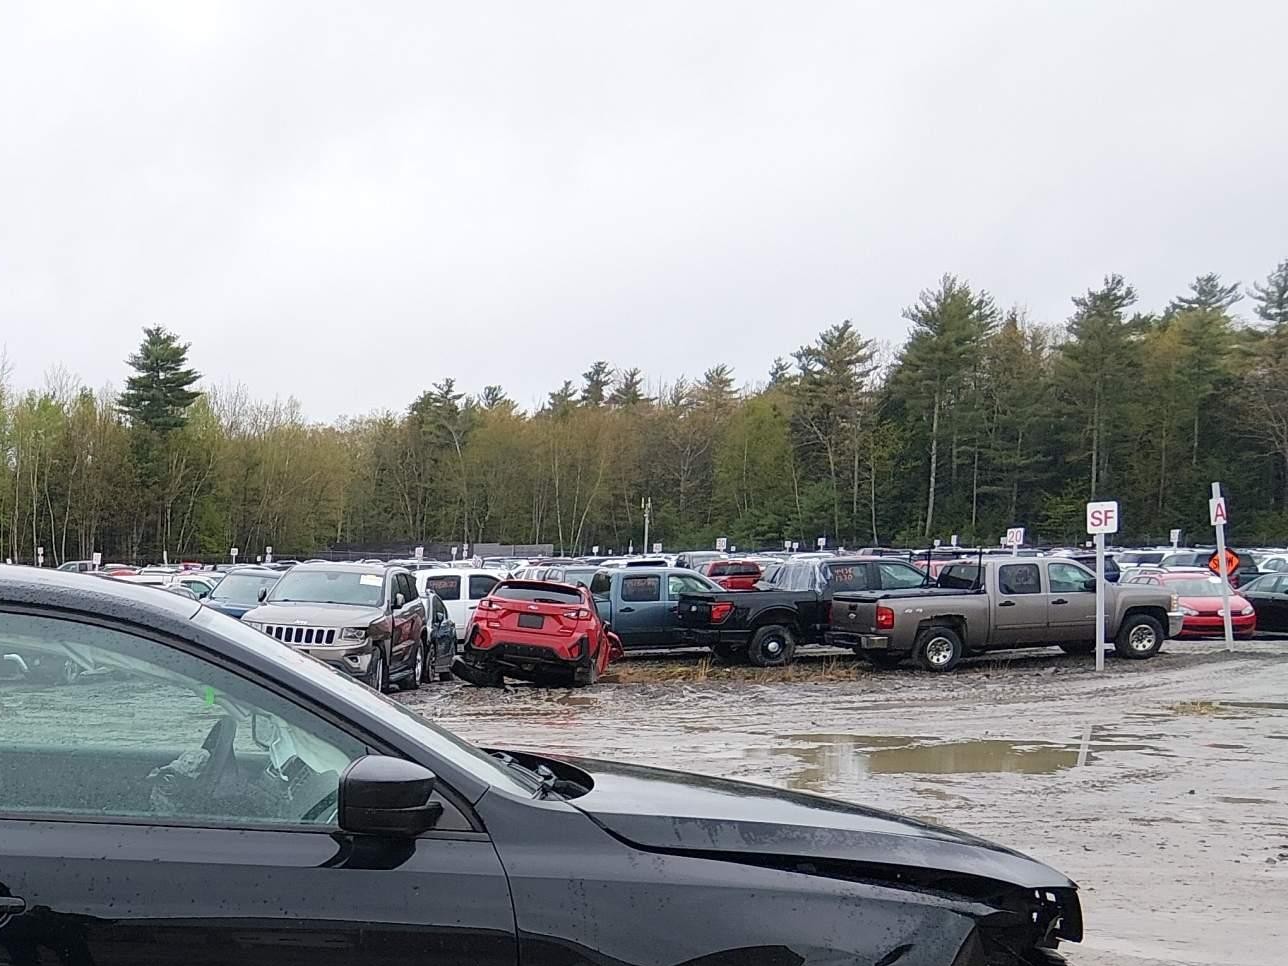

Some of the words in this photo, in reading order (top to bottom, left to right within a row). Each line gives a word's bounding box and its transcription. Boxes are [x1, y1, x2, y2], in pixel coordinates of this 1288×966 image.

[1089, 509, 1115, 527] SF
[1214, 502, 1227, 522] A
[717, 539, 726, 548] 30
[1008, 530, 1022, 543] 20
[1212, 556, 1234, 570] SW
